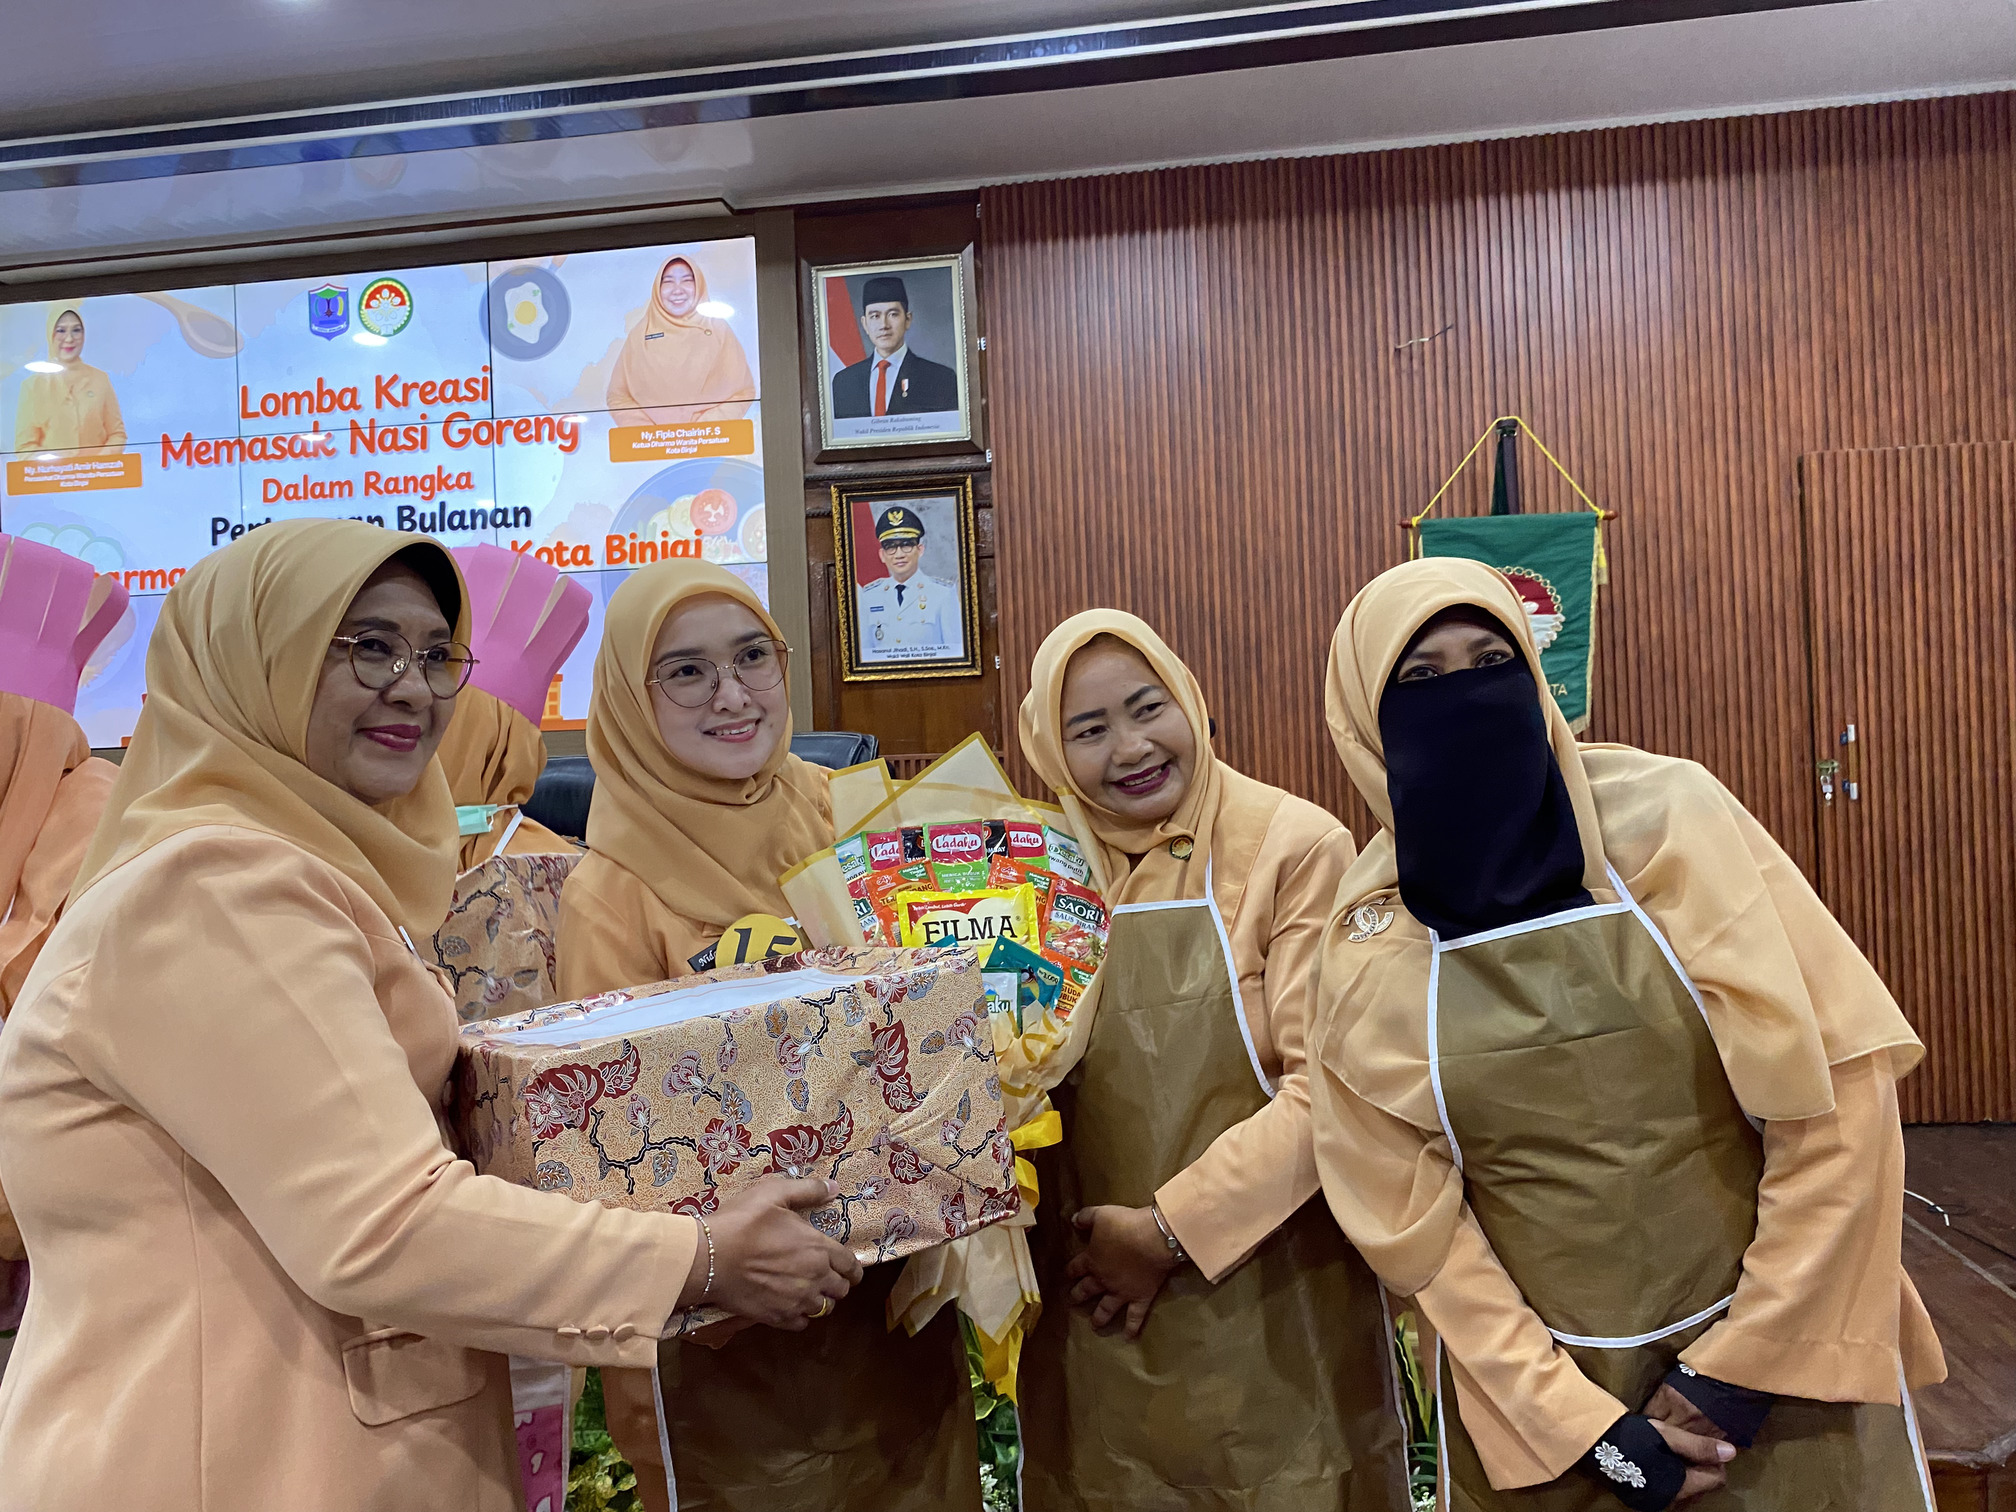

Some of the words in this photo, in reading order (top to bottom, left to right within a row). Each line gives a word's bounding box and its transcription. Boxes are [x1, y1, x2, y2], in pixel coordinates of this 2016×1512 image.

[241, 377, 362, 419] Lomba
[375, 365, 490, 409] Kreasi
[641, 431, 655, 441] Ny.
[714, 426, 721, 435] S
[892, 425, 914, 433] Republik
[160, 420, 337, 469] Memasak
[349, 412, 428, 455] Nasi
[442, 411, 580, 453] Goreng
[262, 474, 354, 504] Dalam
[364, 465, 475, 501] Rangka
[397, 501, 532, 533] Bulanan
[935, 835, 978, 849] Ladaku
[1011, 833, 1039, 846] daku
[874, 842, 899, 858] Lad
[1048, 843, 1085, 867] Desaku
[841, 855, 866, 873] esaku
[1054, 911, 1074, 923] SAUS
[1058, 898, 1099, 921] SAORI
[922, 916, 1018, 945] FILMA
[988, 994, 1011, 1013] aku
